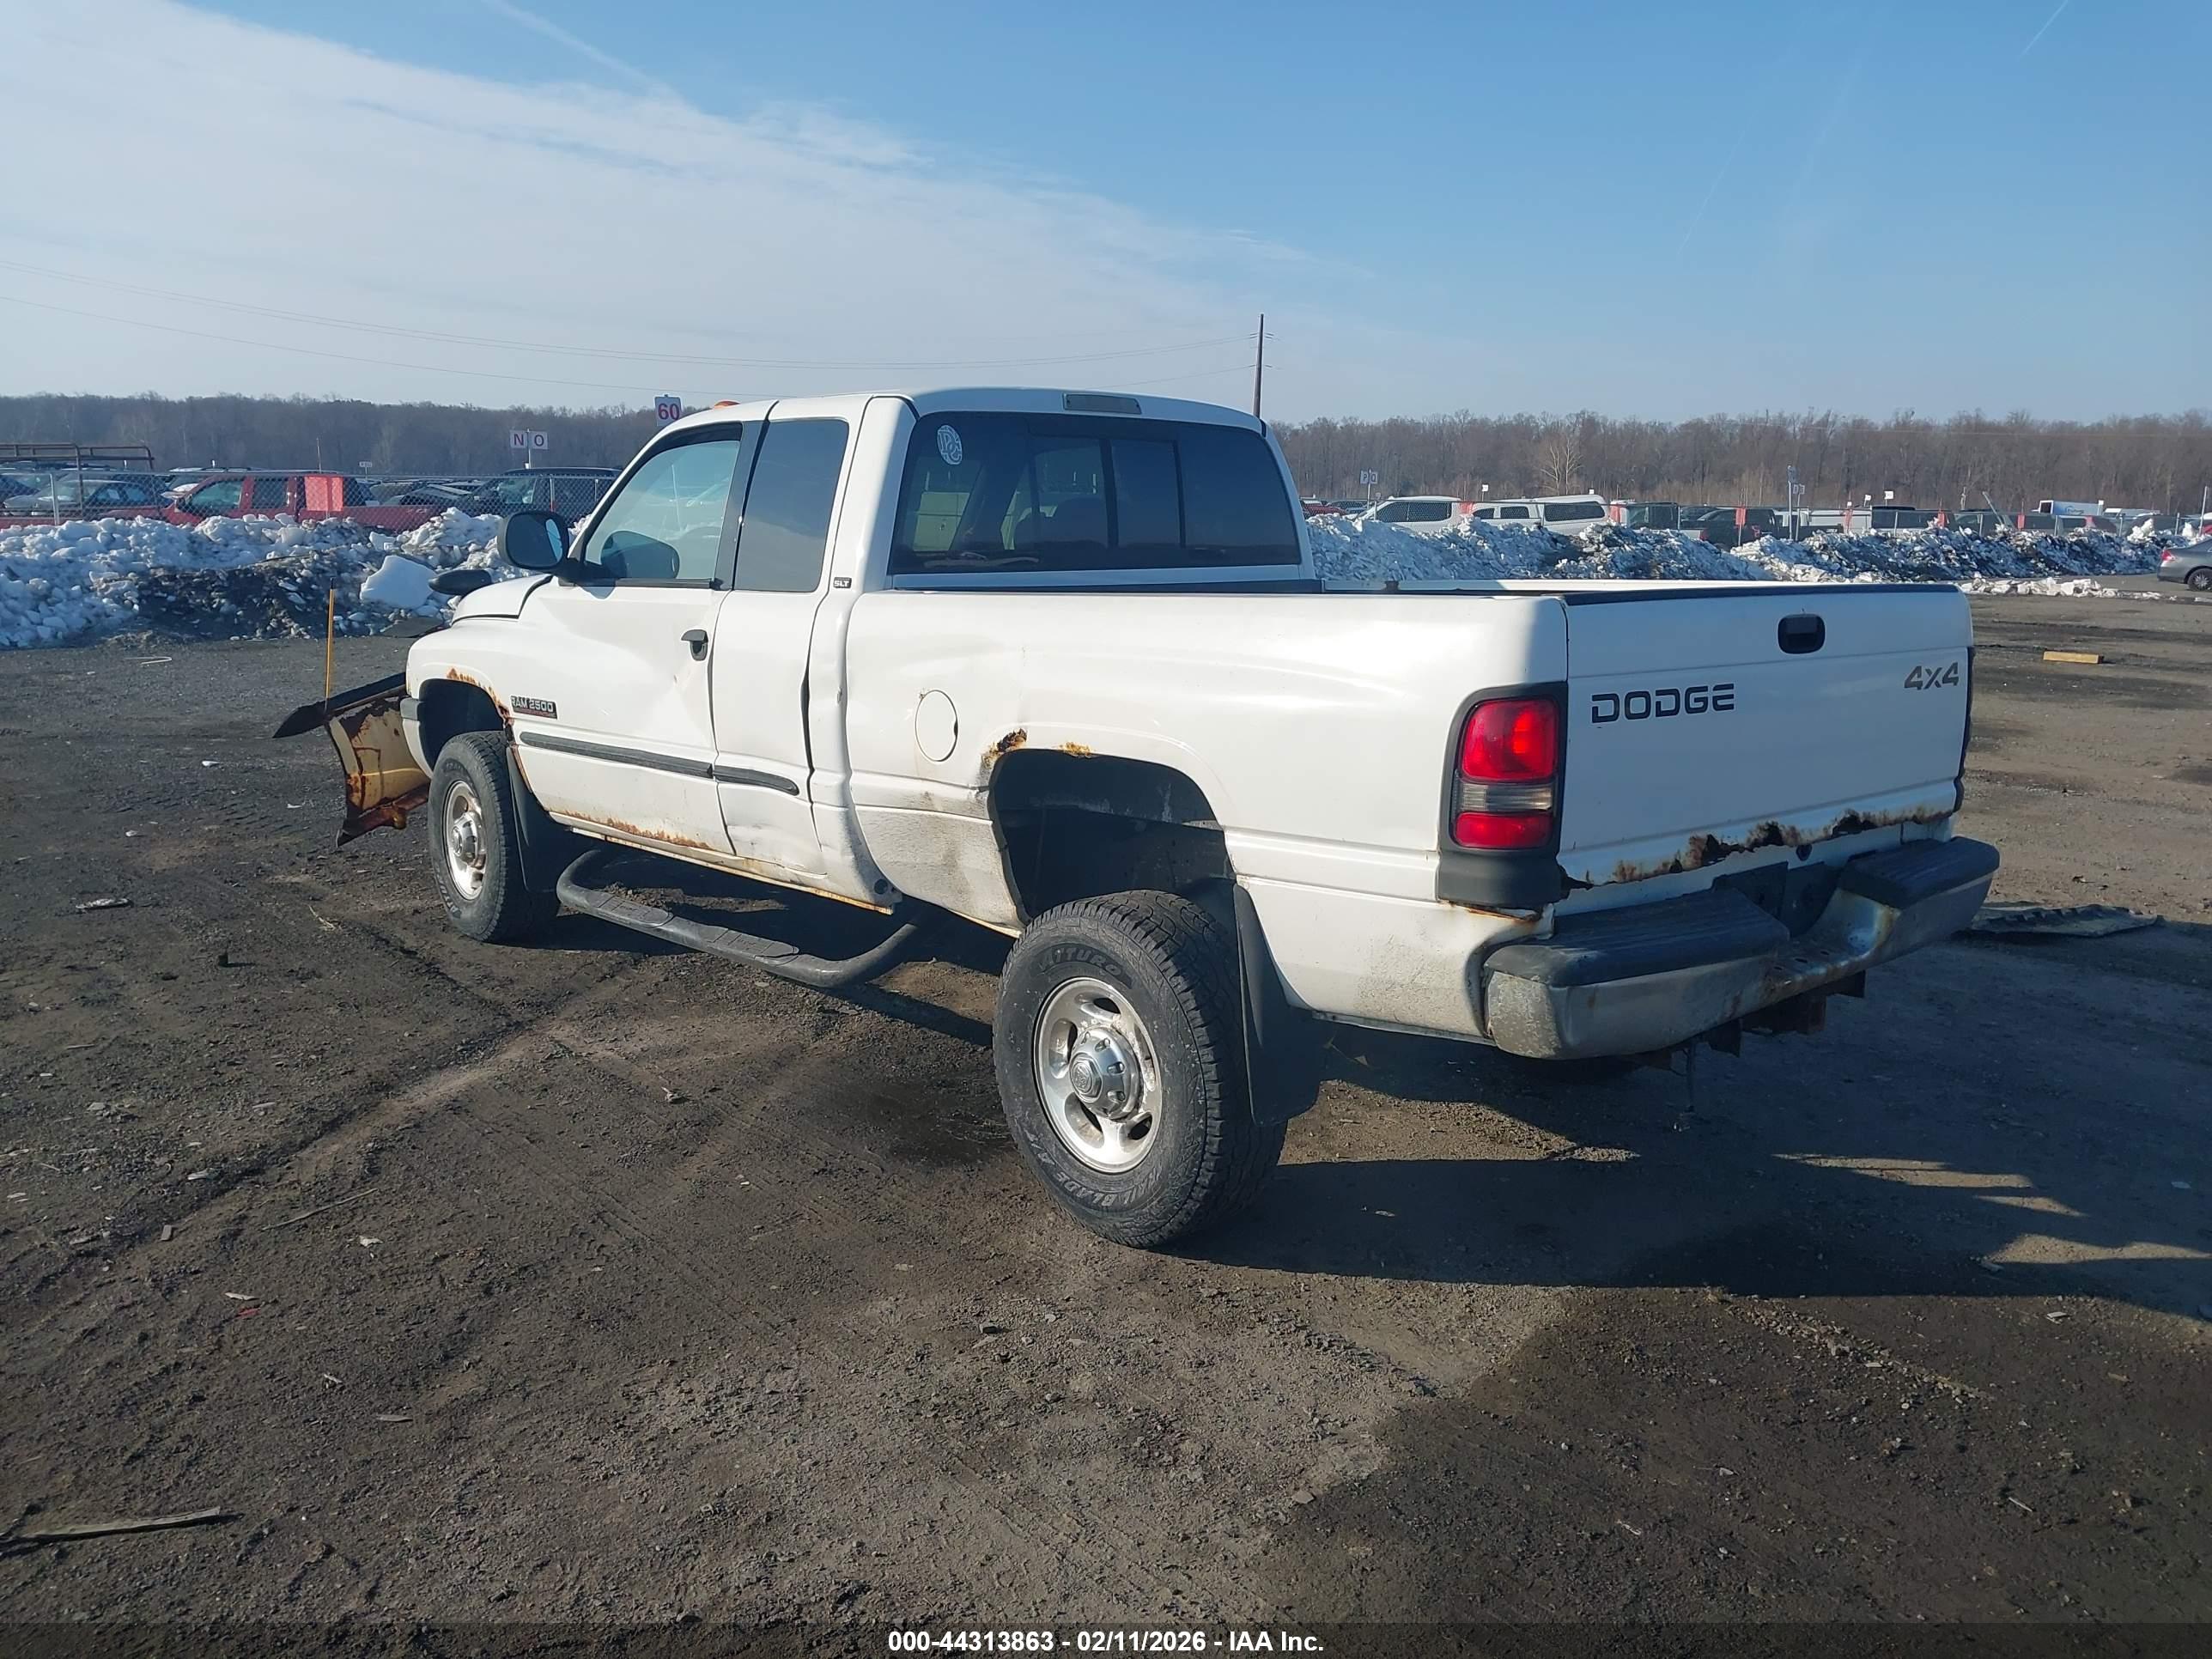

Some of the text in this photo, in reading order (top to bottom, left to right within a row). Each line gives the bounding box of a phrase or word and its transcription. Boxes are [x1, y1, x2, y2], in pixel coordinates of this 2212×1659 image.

[658, 403, 680, 421] 60
[514, 434, 525, 446] N
[534, 434, 544, 447] O
[510, 696, 528, 708] RAM
[529, 699, 554, 713] 2500
[1591, 683, 1735, 723] DODGE
[1053, 1170, 1118, 1206] BLADE
